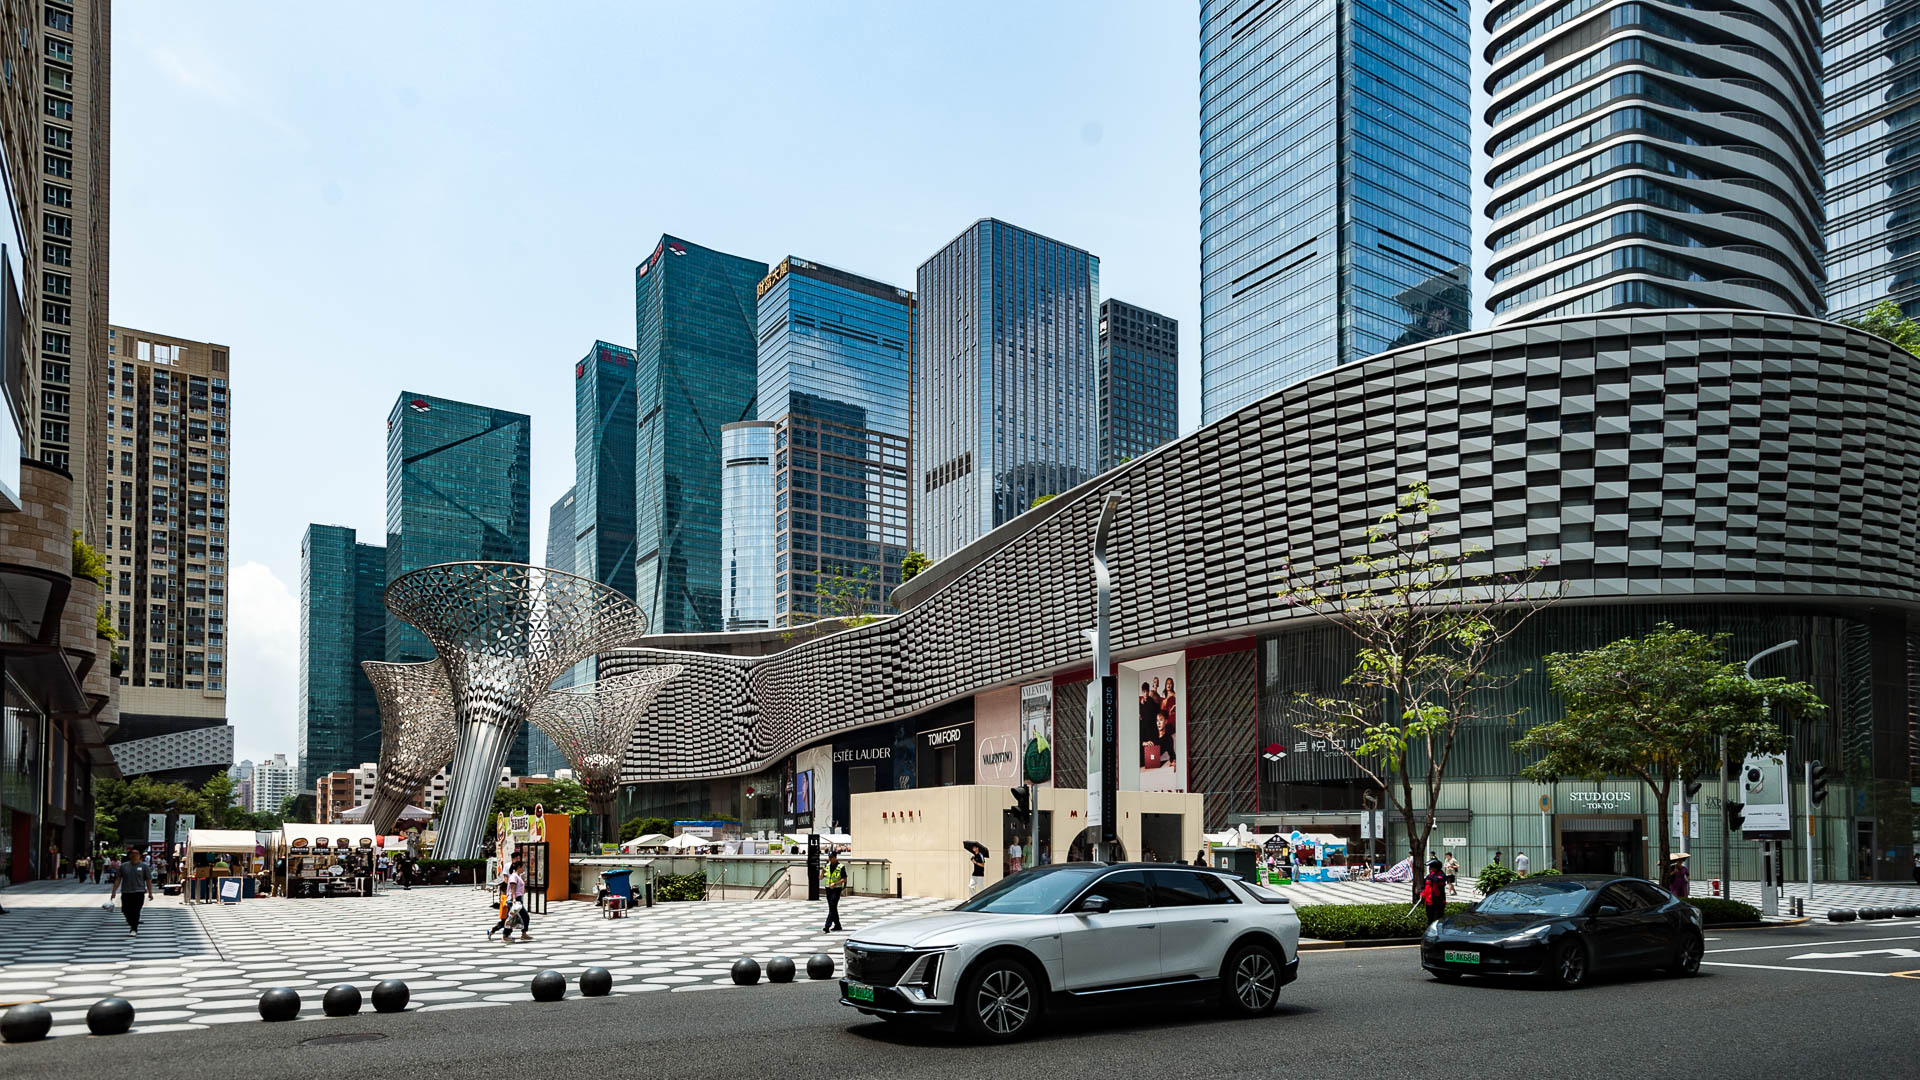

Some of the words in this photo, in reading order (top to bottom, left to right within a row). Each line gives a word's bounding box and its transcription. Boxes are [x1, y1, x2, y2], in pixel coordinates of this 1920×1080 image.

[928, 732, 942, 746] TOM
[943, 728, 960, 743] FORD
[855, 747, 891, 760] LAUDER
[983, 751, 1013, 765] VALENTINO
[1570, 791, 1631, 801] STUDIOUS
